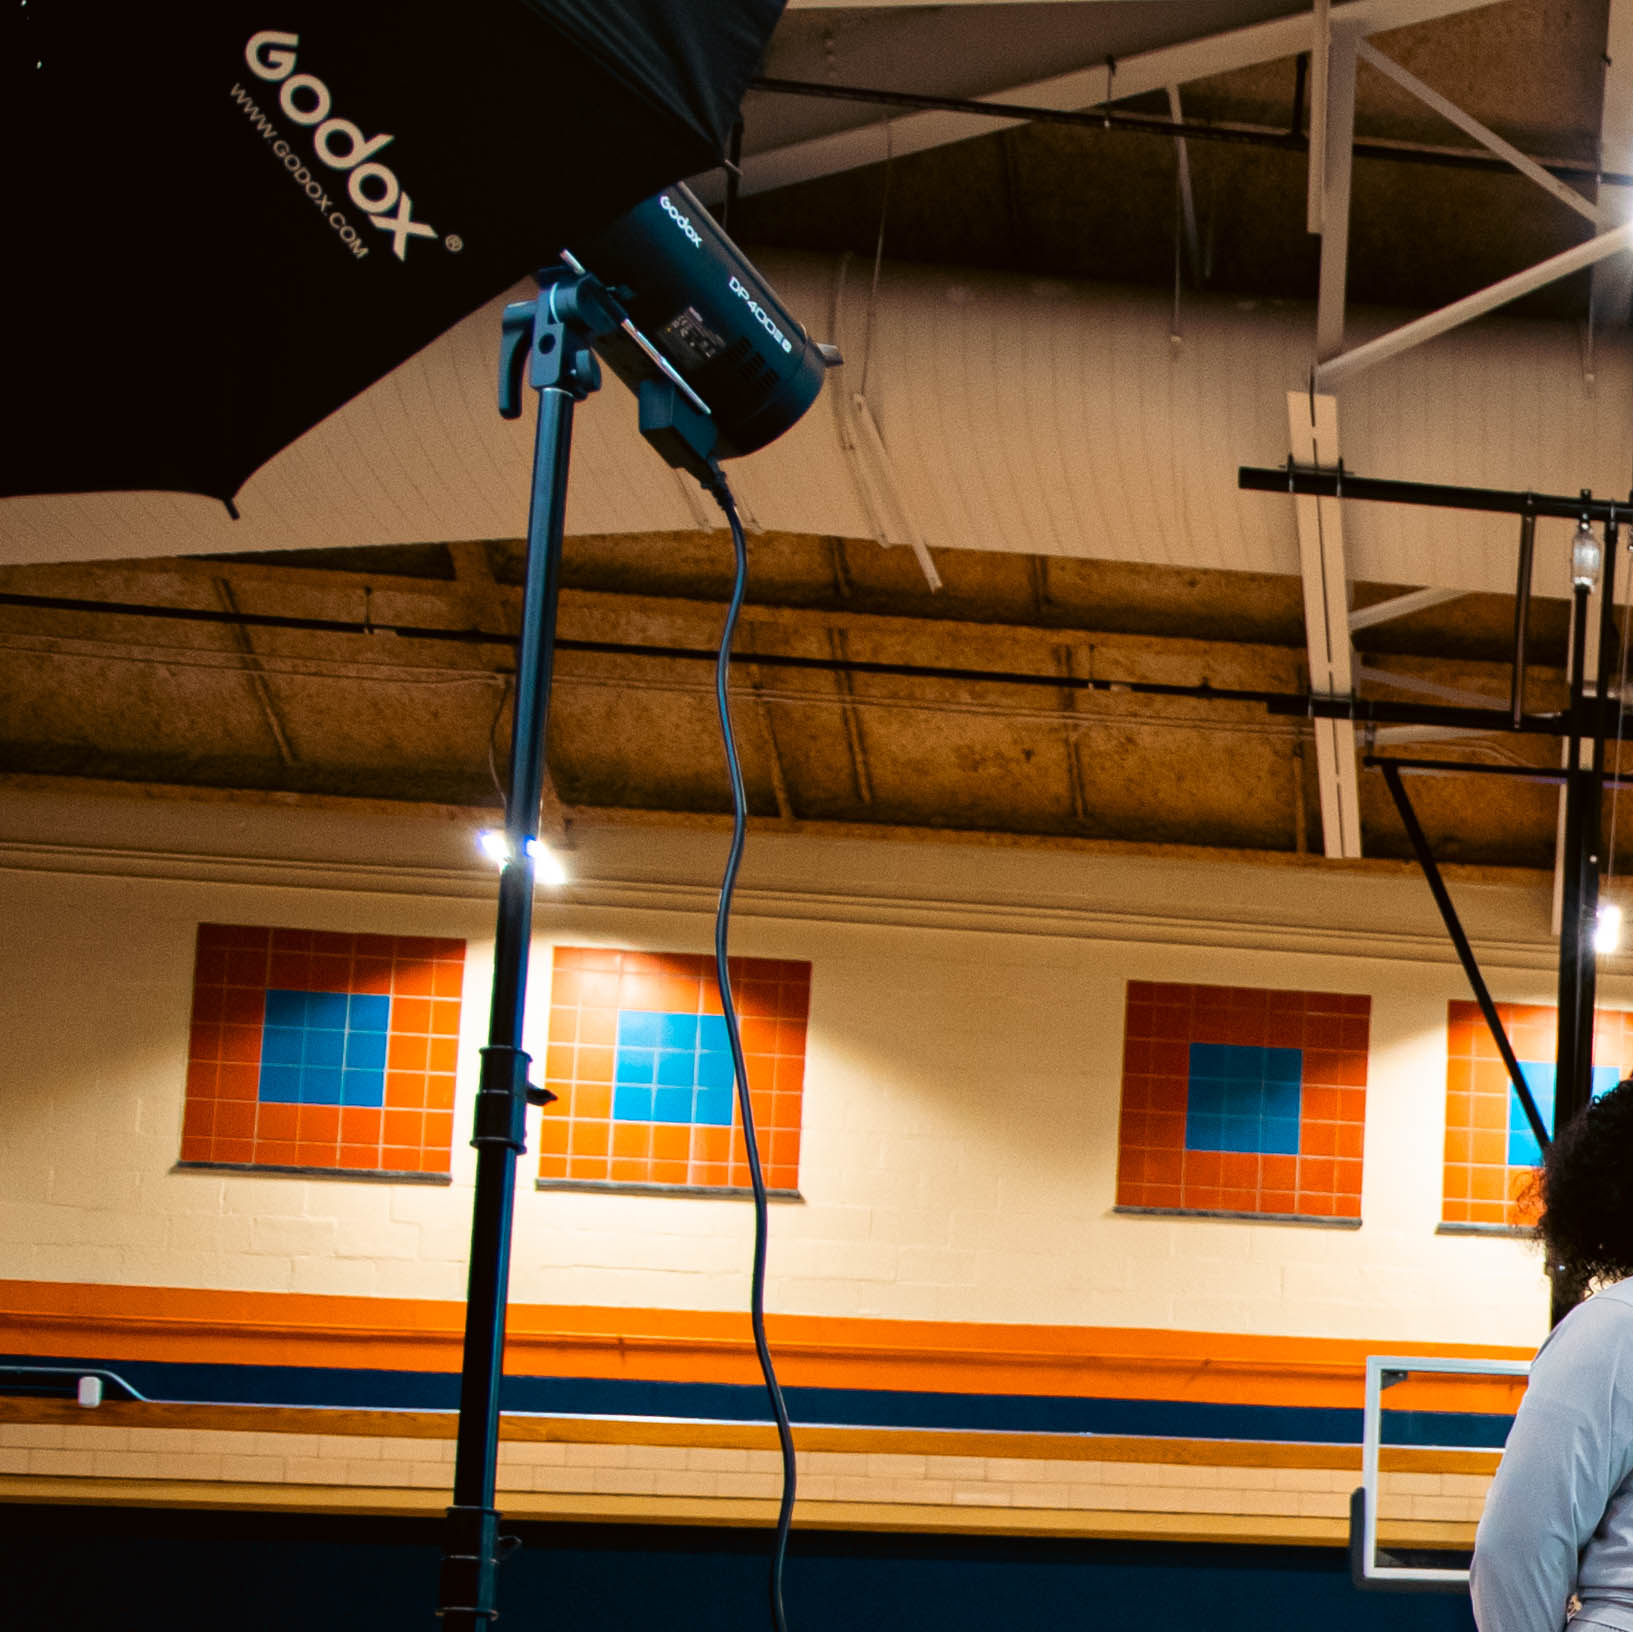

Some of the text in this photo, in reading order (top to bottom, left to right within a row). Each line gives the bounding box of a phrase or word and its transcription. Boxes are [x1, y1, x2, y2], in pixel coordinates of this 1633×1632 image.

[230, 83, 369, 258] WWW.GODOX.COM
[245, 30, 438, 262] Godox
[660, 196, 703, 248] Godox
